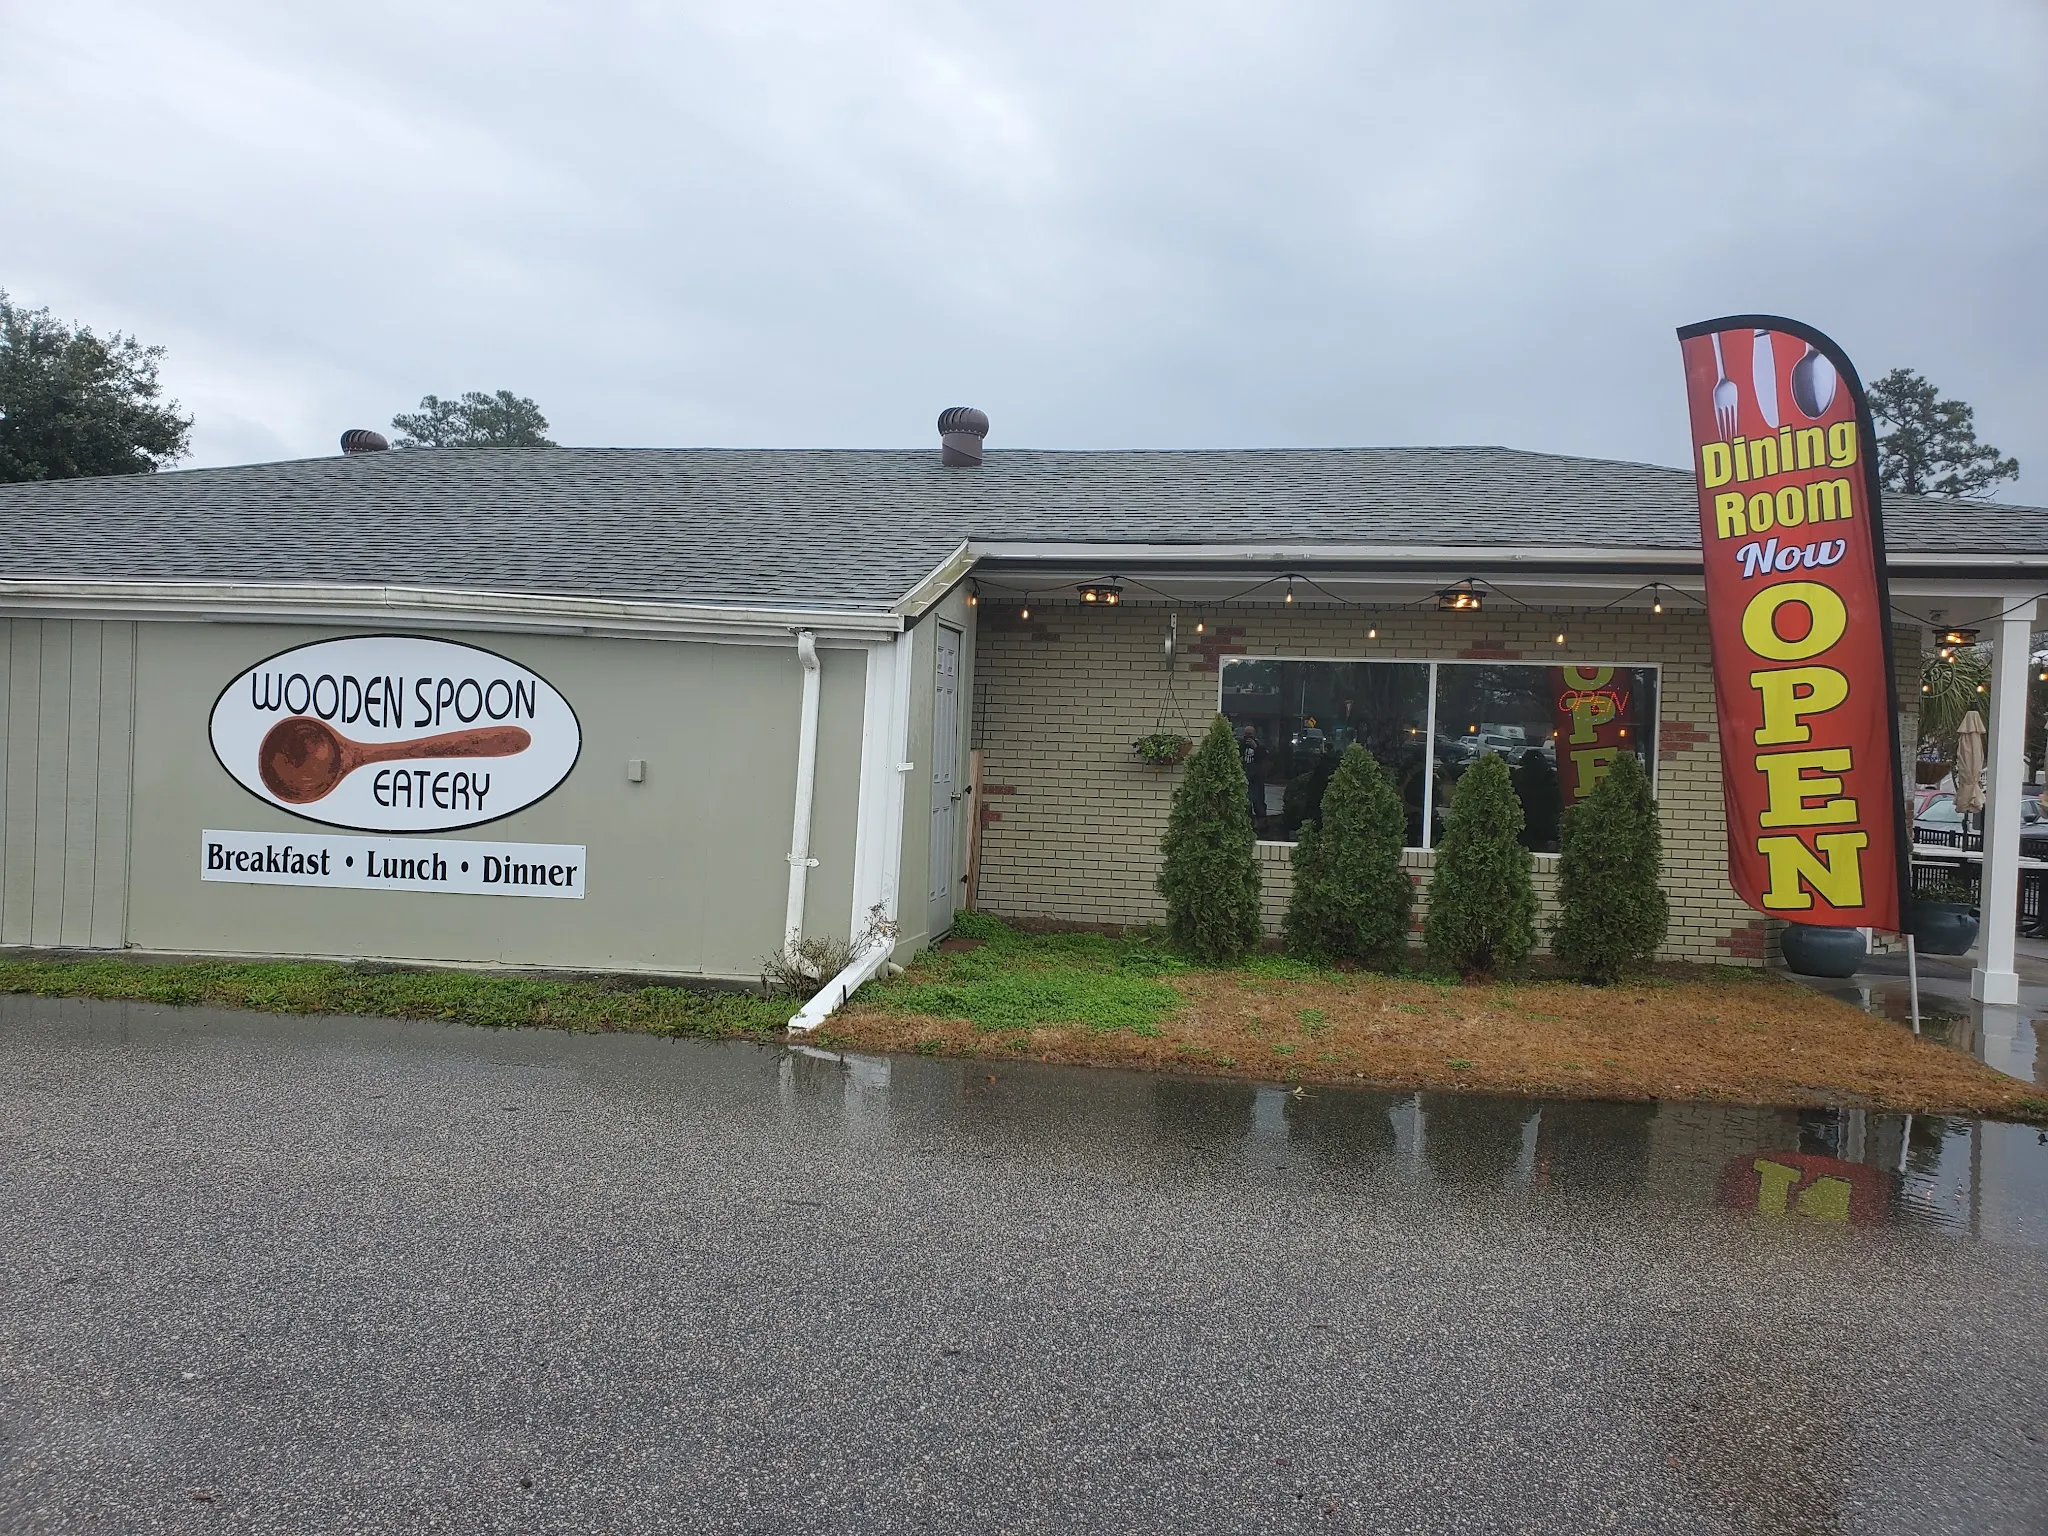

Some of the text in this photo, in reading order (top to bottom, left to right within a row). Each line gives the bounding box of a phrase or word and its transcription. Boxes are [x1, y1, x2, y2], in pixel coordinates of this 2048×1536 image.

[1701, 420, 1857, 489] Dining
[1714, 477, 1853, 540] Room
[1736, 537, 1846, 580] Now
[251, 672, 536, 729] WOODEN SPOON
[1558, 689, 1630, 713] OPEN
[1741, 580, 1869, 911] OPEN
[373, 769, 491, 811] EATERY
[206, 843, 578, 887] Breakfast Lunch Dinner
